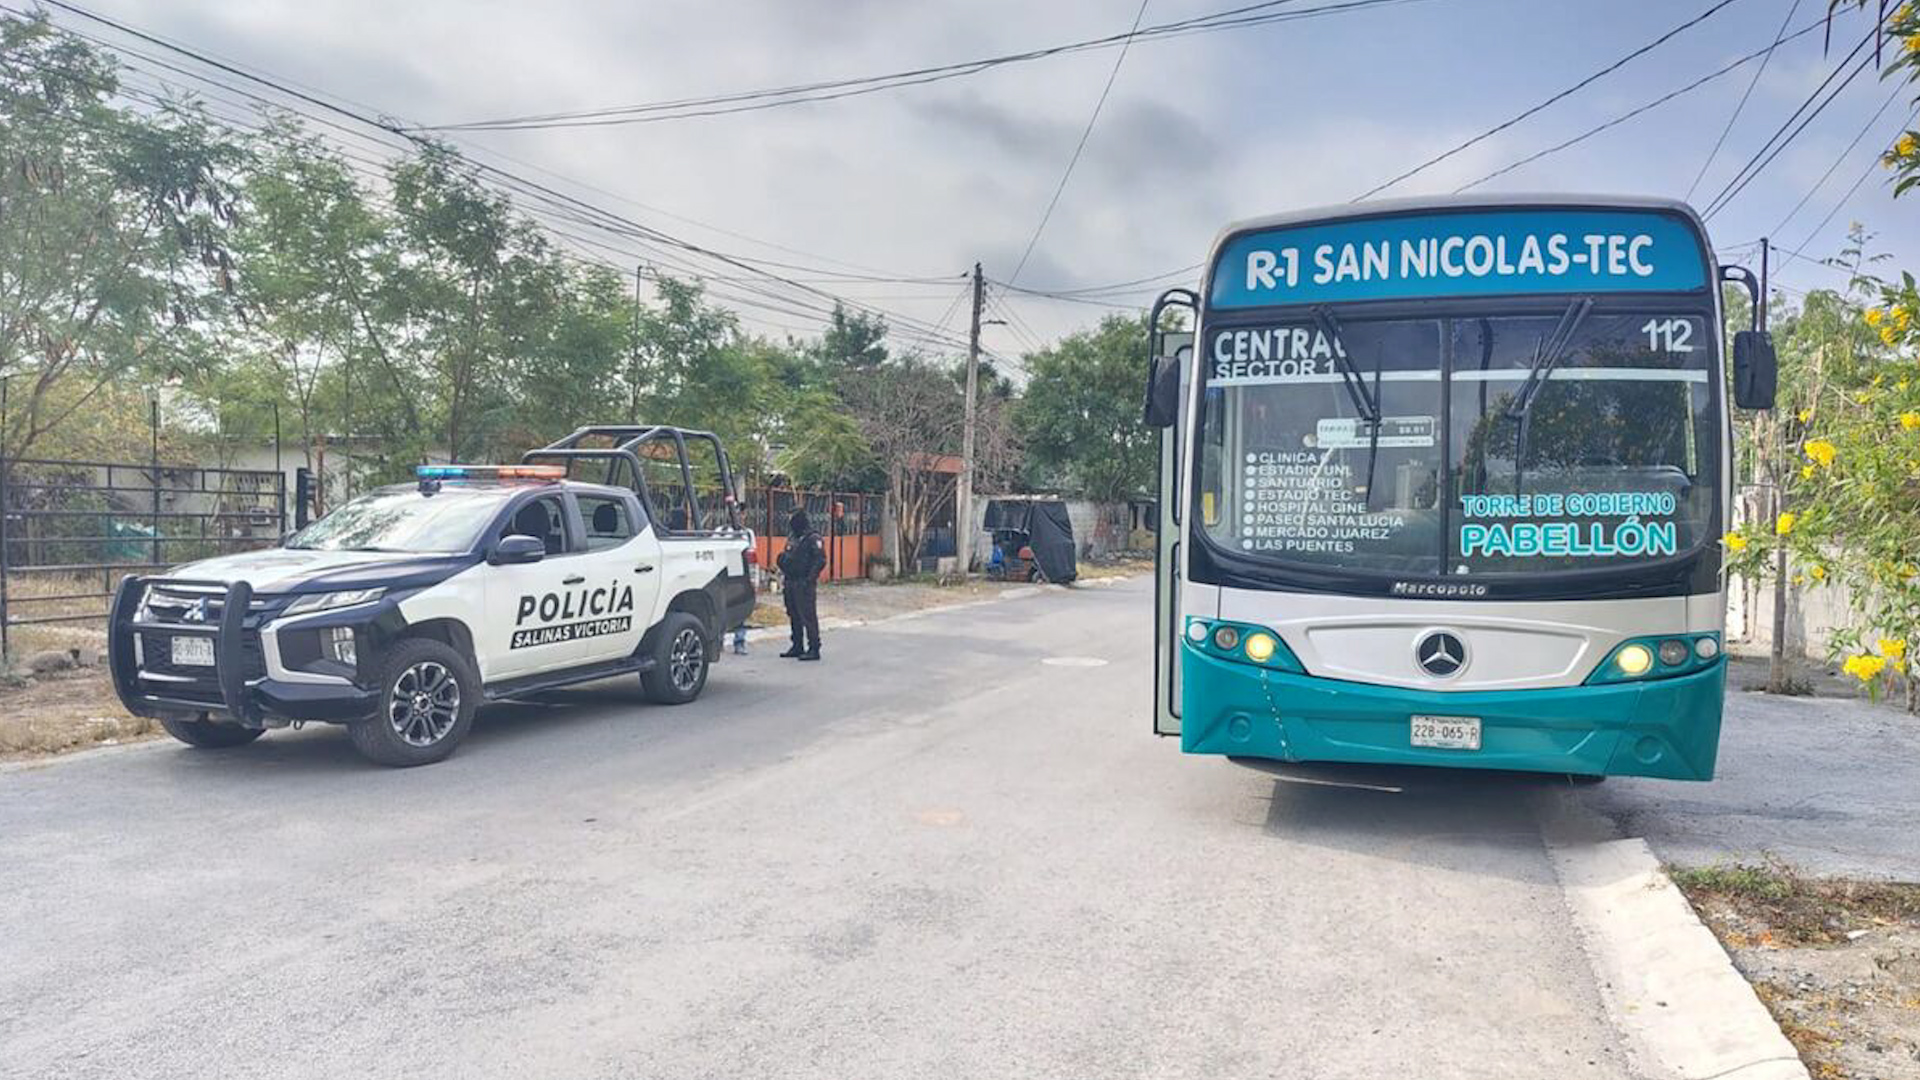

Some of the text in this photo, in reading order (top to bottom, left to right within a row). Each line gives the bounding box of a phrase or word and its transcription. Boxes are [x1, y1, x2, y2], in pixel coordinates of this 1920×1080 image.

[1246, 234, 1655, 291] R-1 SAN NICOLAS-TEC
[1642, 318, 1694, 353] 112
[1216, 360, 1316, 380] SECTOR
[1259, 453, 1317, 463] CLINICA
[1259, 465, 1319, 475] ESTADIO
[1258, 478, 1342, 488] SANTUARIO
[1258, 490, 1352, 500] ESTADIO TEC
[1257, 502, 1328, 513] HOSPITAL
[1461, 491, 1676, 517] TORRE DE GOBIERNO
[1256, 514, 1404, 527] PASEO SANTA LUCIA
[1256, 527, 1390, 540] MERCADO JUAREZ
[1460, 516, 1677, 557] PABELLÓN
[1256, 540, 1354, 552] LAS PUENTES
[1393, 582, 1487, 596] Marcopolo
[516, 579, 634, 626] POLICÍA
[514, 618, 629, 647] SALINAS VICTORIA
